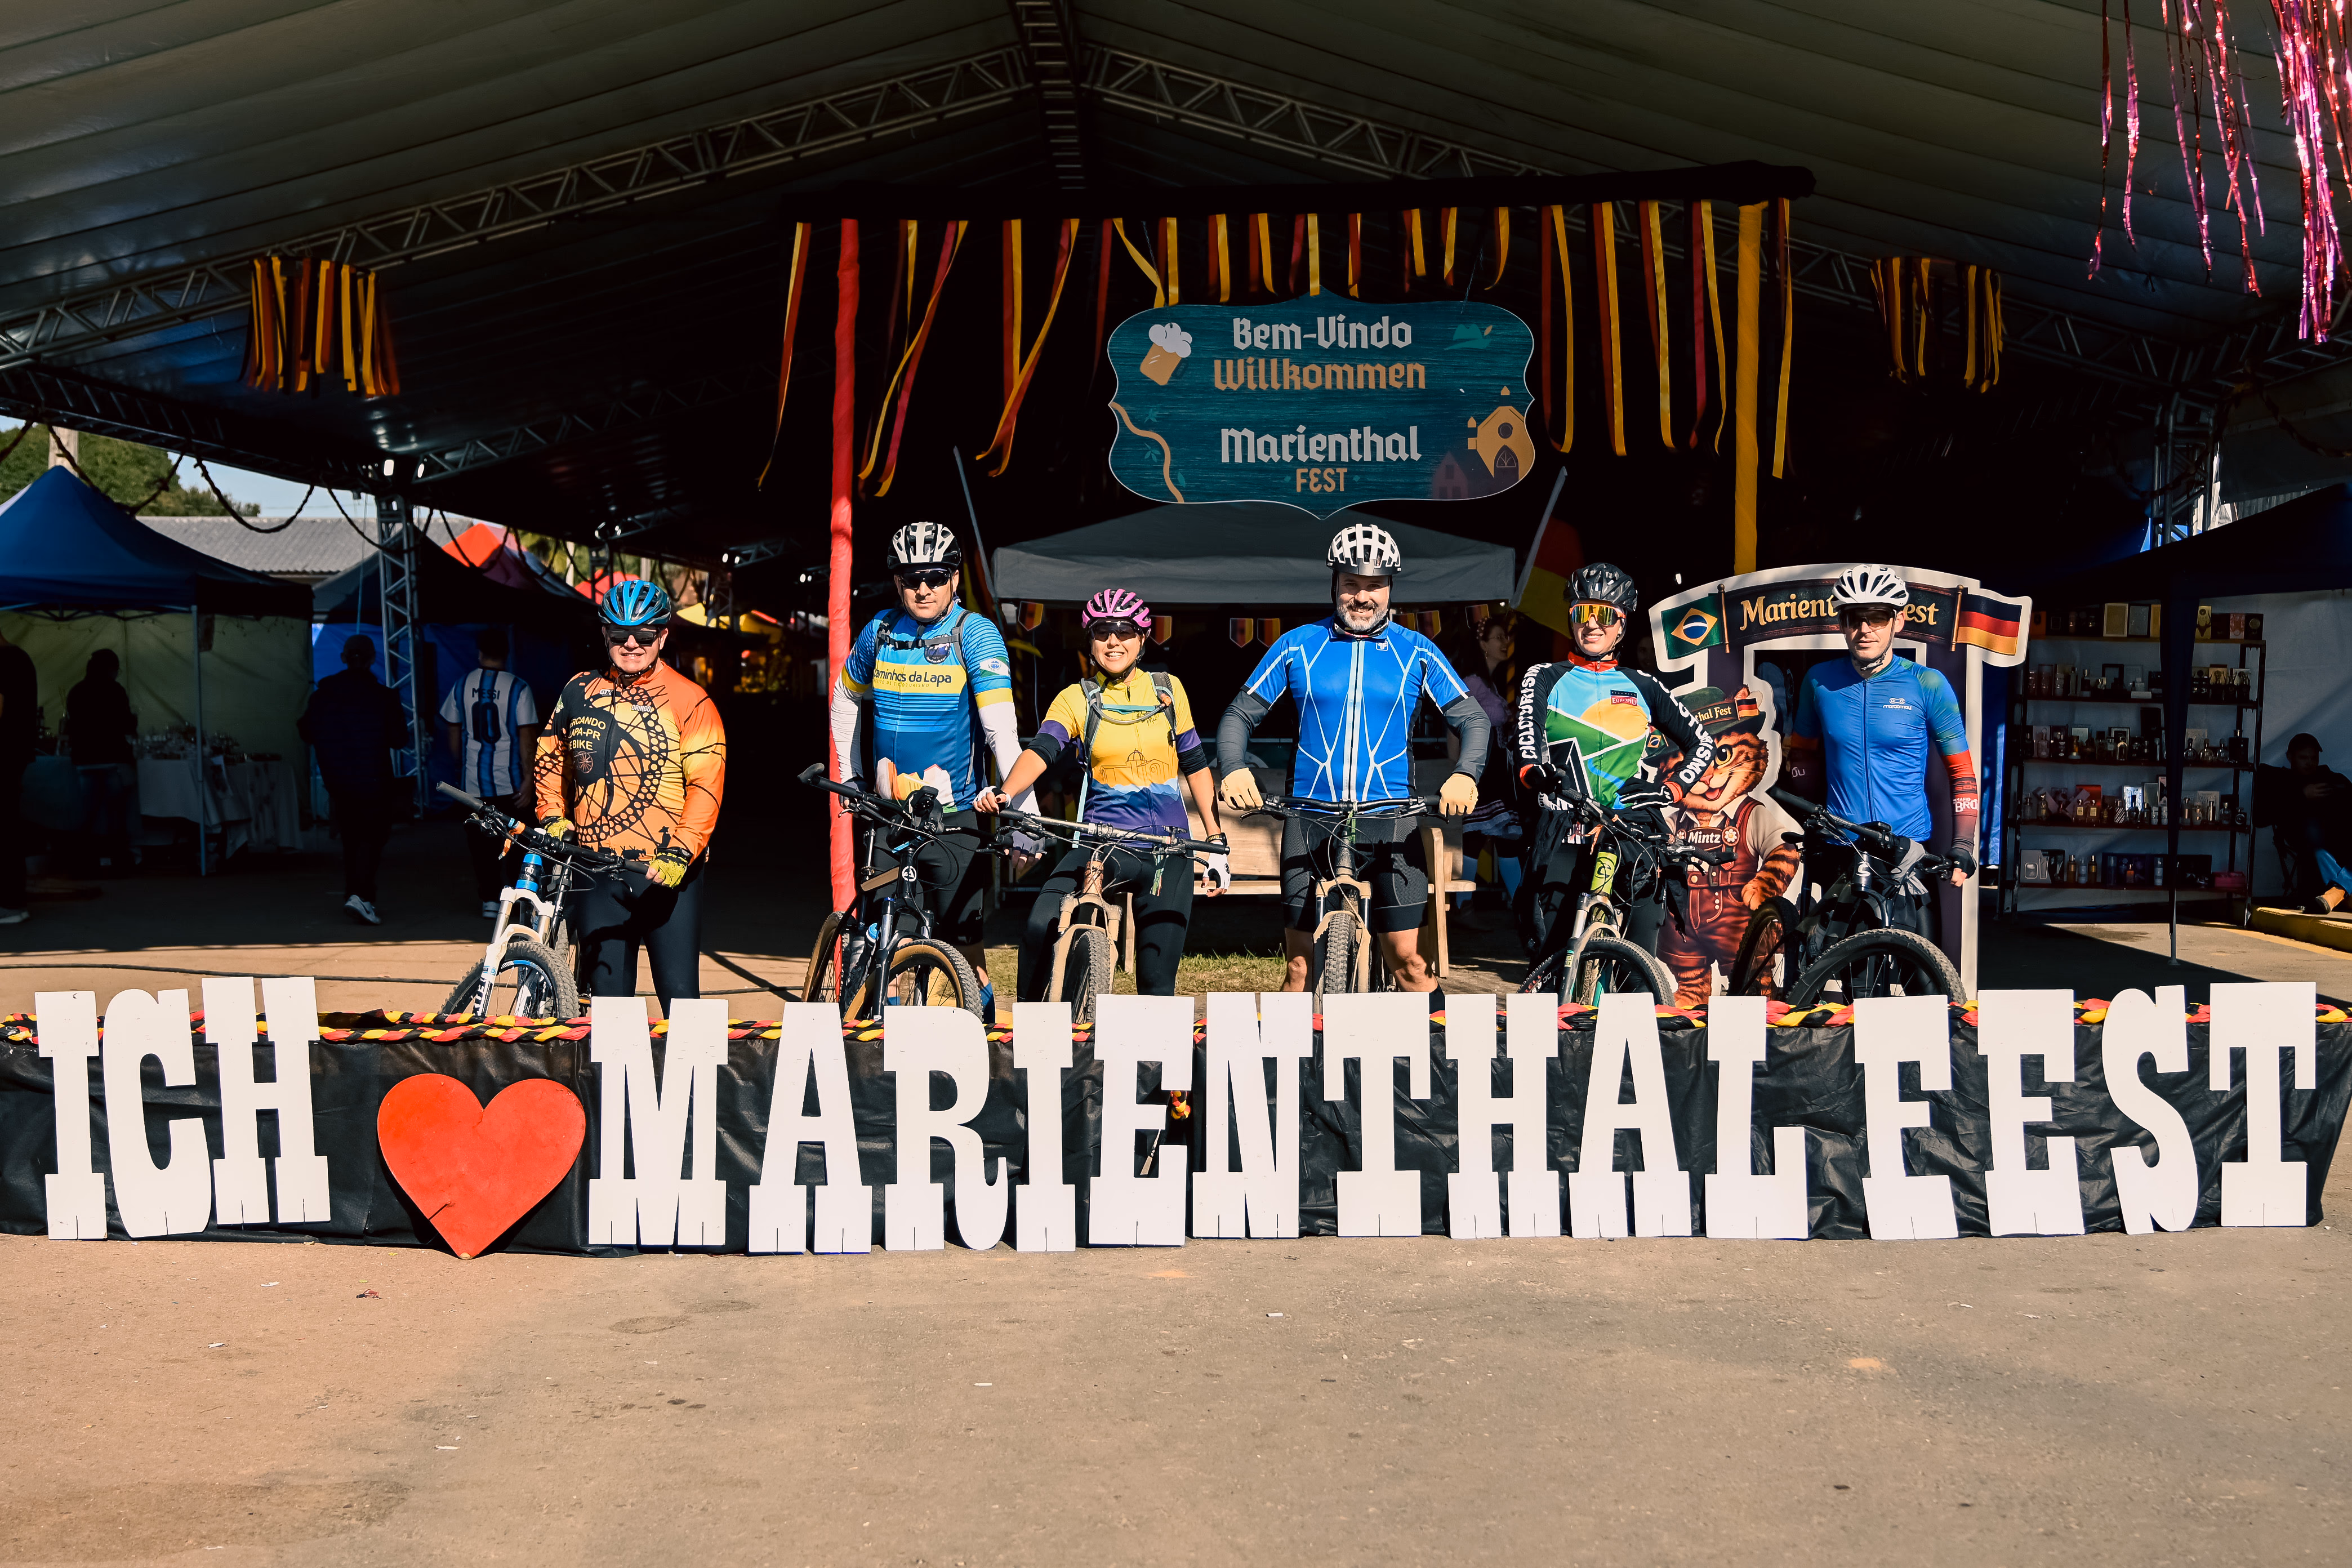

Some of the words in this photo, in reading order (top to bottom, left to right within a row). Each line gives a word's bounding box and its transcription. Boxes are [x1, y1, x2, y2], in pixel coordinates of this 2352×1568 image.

[1232, 314, 1413, 351] Bem-Vindo
[1213, 356, 1427, 391] Willkommen
[1220, 425, 1422, 463] Marienthal
[1295, 467, 1347, 493] FEST
[1739, 593, 1838, 631] Marient
[1903, 603, 1939, 625] est
[908, 671, 923, 683] da
[924, 671, 952, 688] Lapa
[472, 687, 500, 700] MESSI
[631, 704, 652, 712] GRINGO
[1713, 706, 1732, 719] Fest
[572, 739, 593, 751] BIKE
[1687, 831, 1721, 844] Mintz
[34, 975, 332, 1240] ICH
